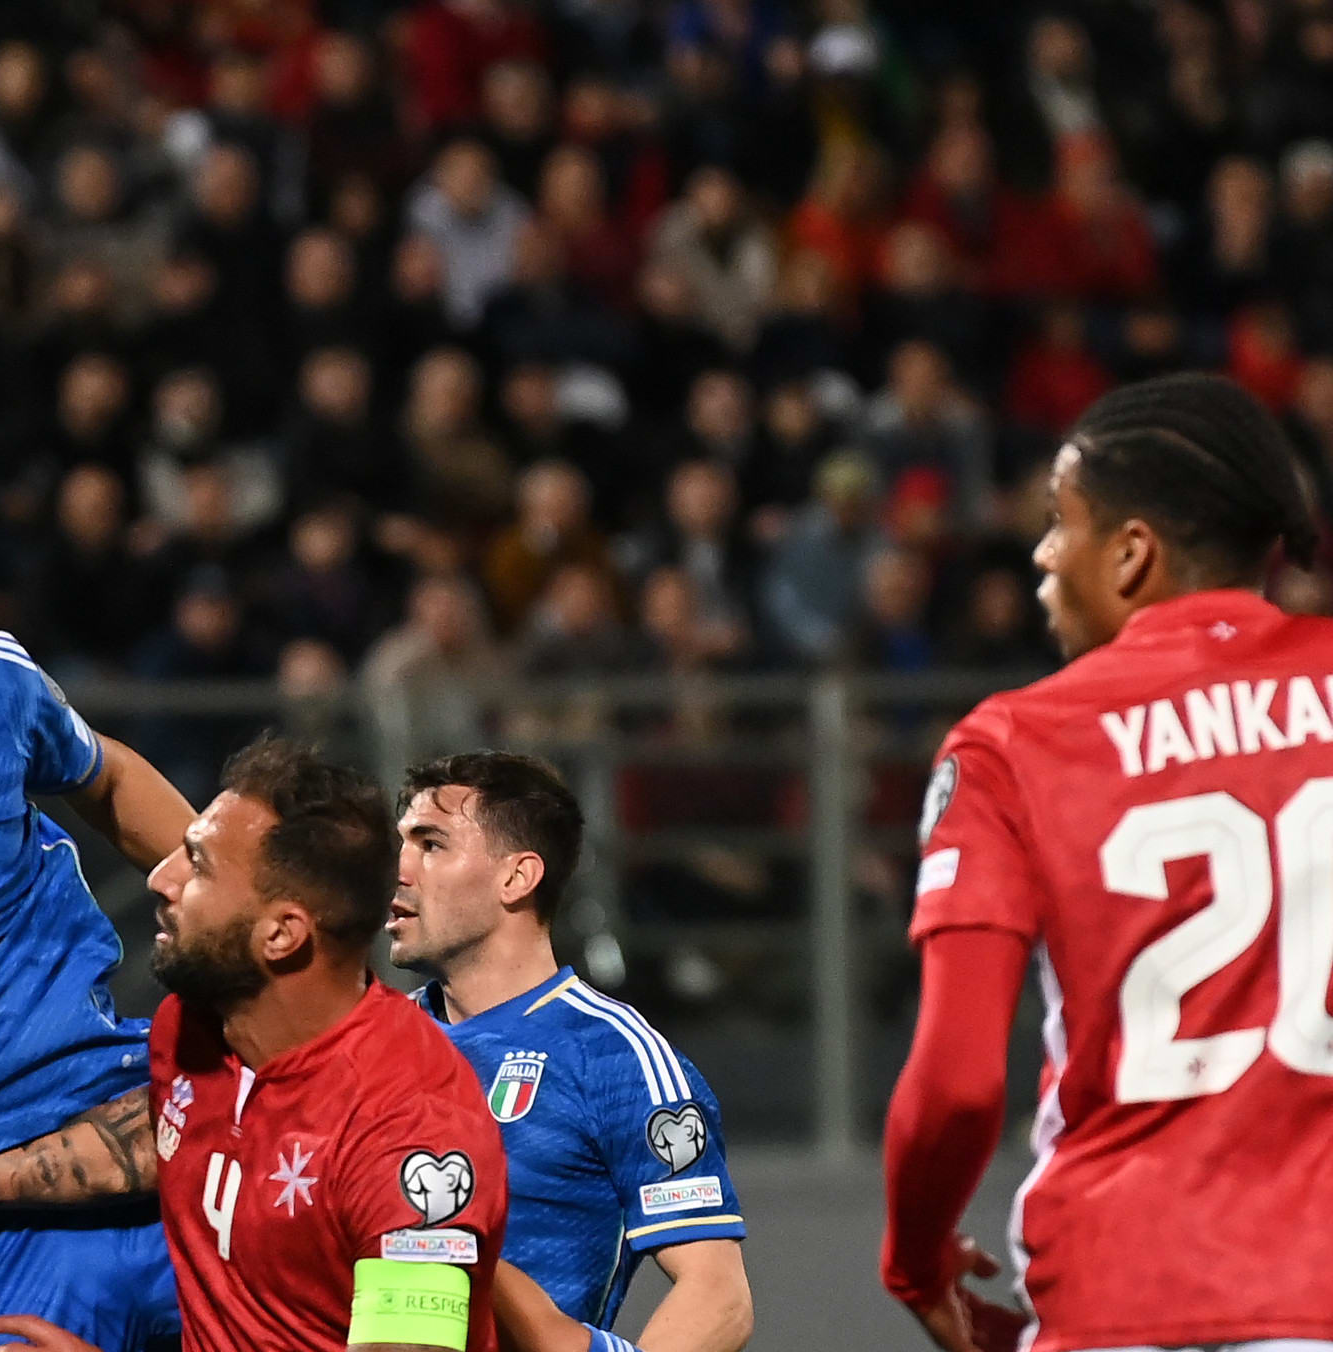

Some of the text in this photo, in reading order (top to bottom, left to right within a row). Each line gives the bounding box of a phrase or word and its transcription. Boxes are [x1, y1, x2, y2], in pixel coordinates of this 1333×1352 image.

[1100, 672, 1333, 778] YANKA
[501, 1064, 537, 1078] ITALIA
[643, 1185, 720, 1204] FOUNDATION
[201, 1151, 243, 1261] 4
[384, 1237, 475, 1250] FOUNDATION
[405, 1294, 469, 1317] RESPEC
